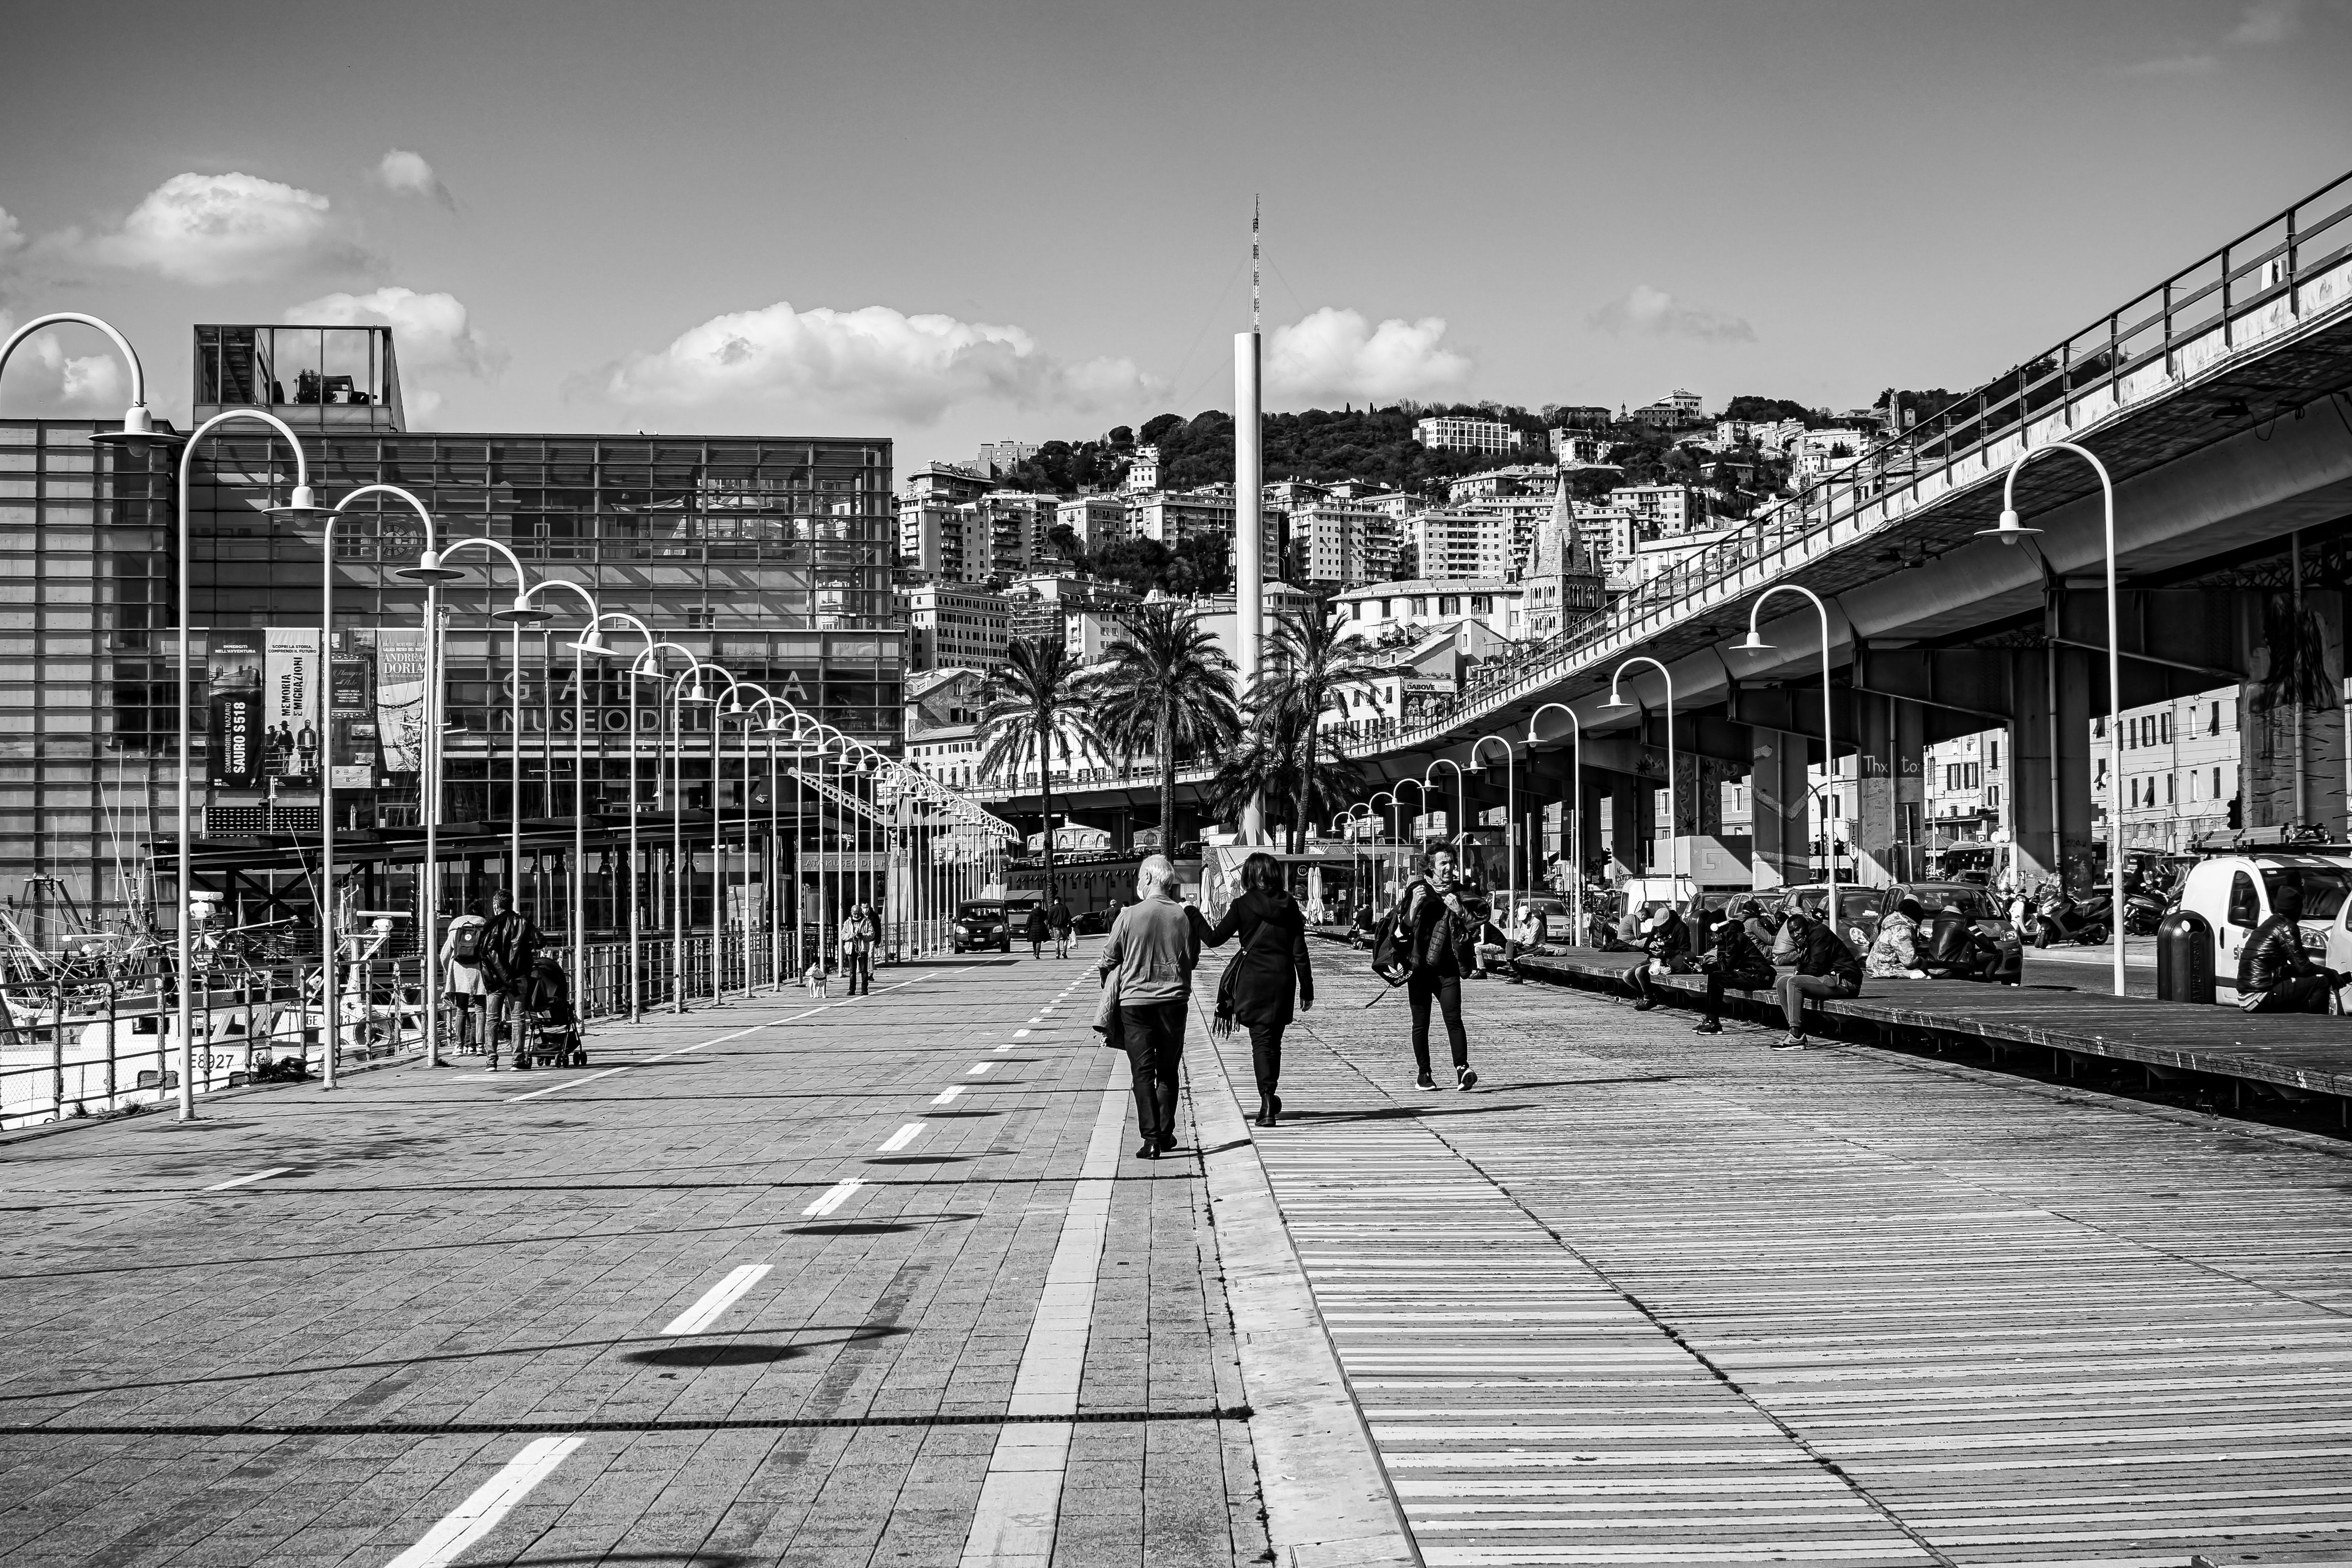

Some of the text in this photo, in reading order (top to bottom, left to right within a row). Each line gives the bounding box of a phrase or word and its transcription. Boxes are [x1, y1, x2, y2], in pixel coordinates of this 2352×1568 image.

[383, 653, 424, 662] ANDREA
[383, 663, 424, 674] DORIA
[503, 671, 808, 700] GALATA
[281, 674, 291, 716] MEMORIA
[503, 709, 628, 731] MUSEO
[640, 709, 708, 731] DEL
[234, 702, 246, 773] SAURO S518
[1863, 755, 1920, 773] Thx to:
[1394, 970, 1413, 984] adidas
[179, 1054, 234, 1069] E8927
